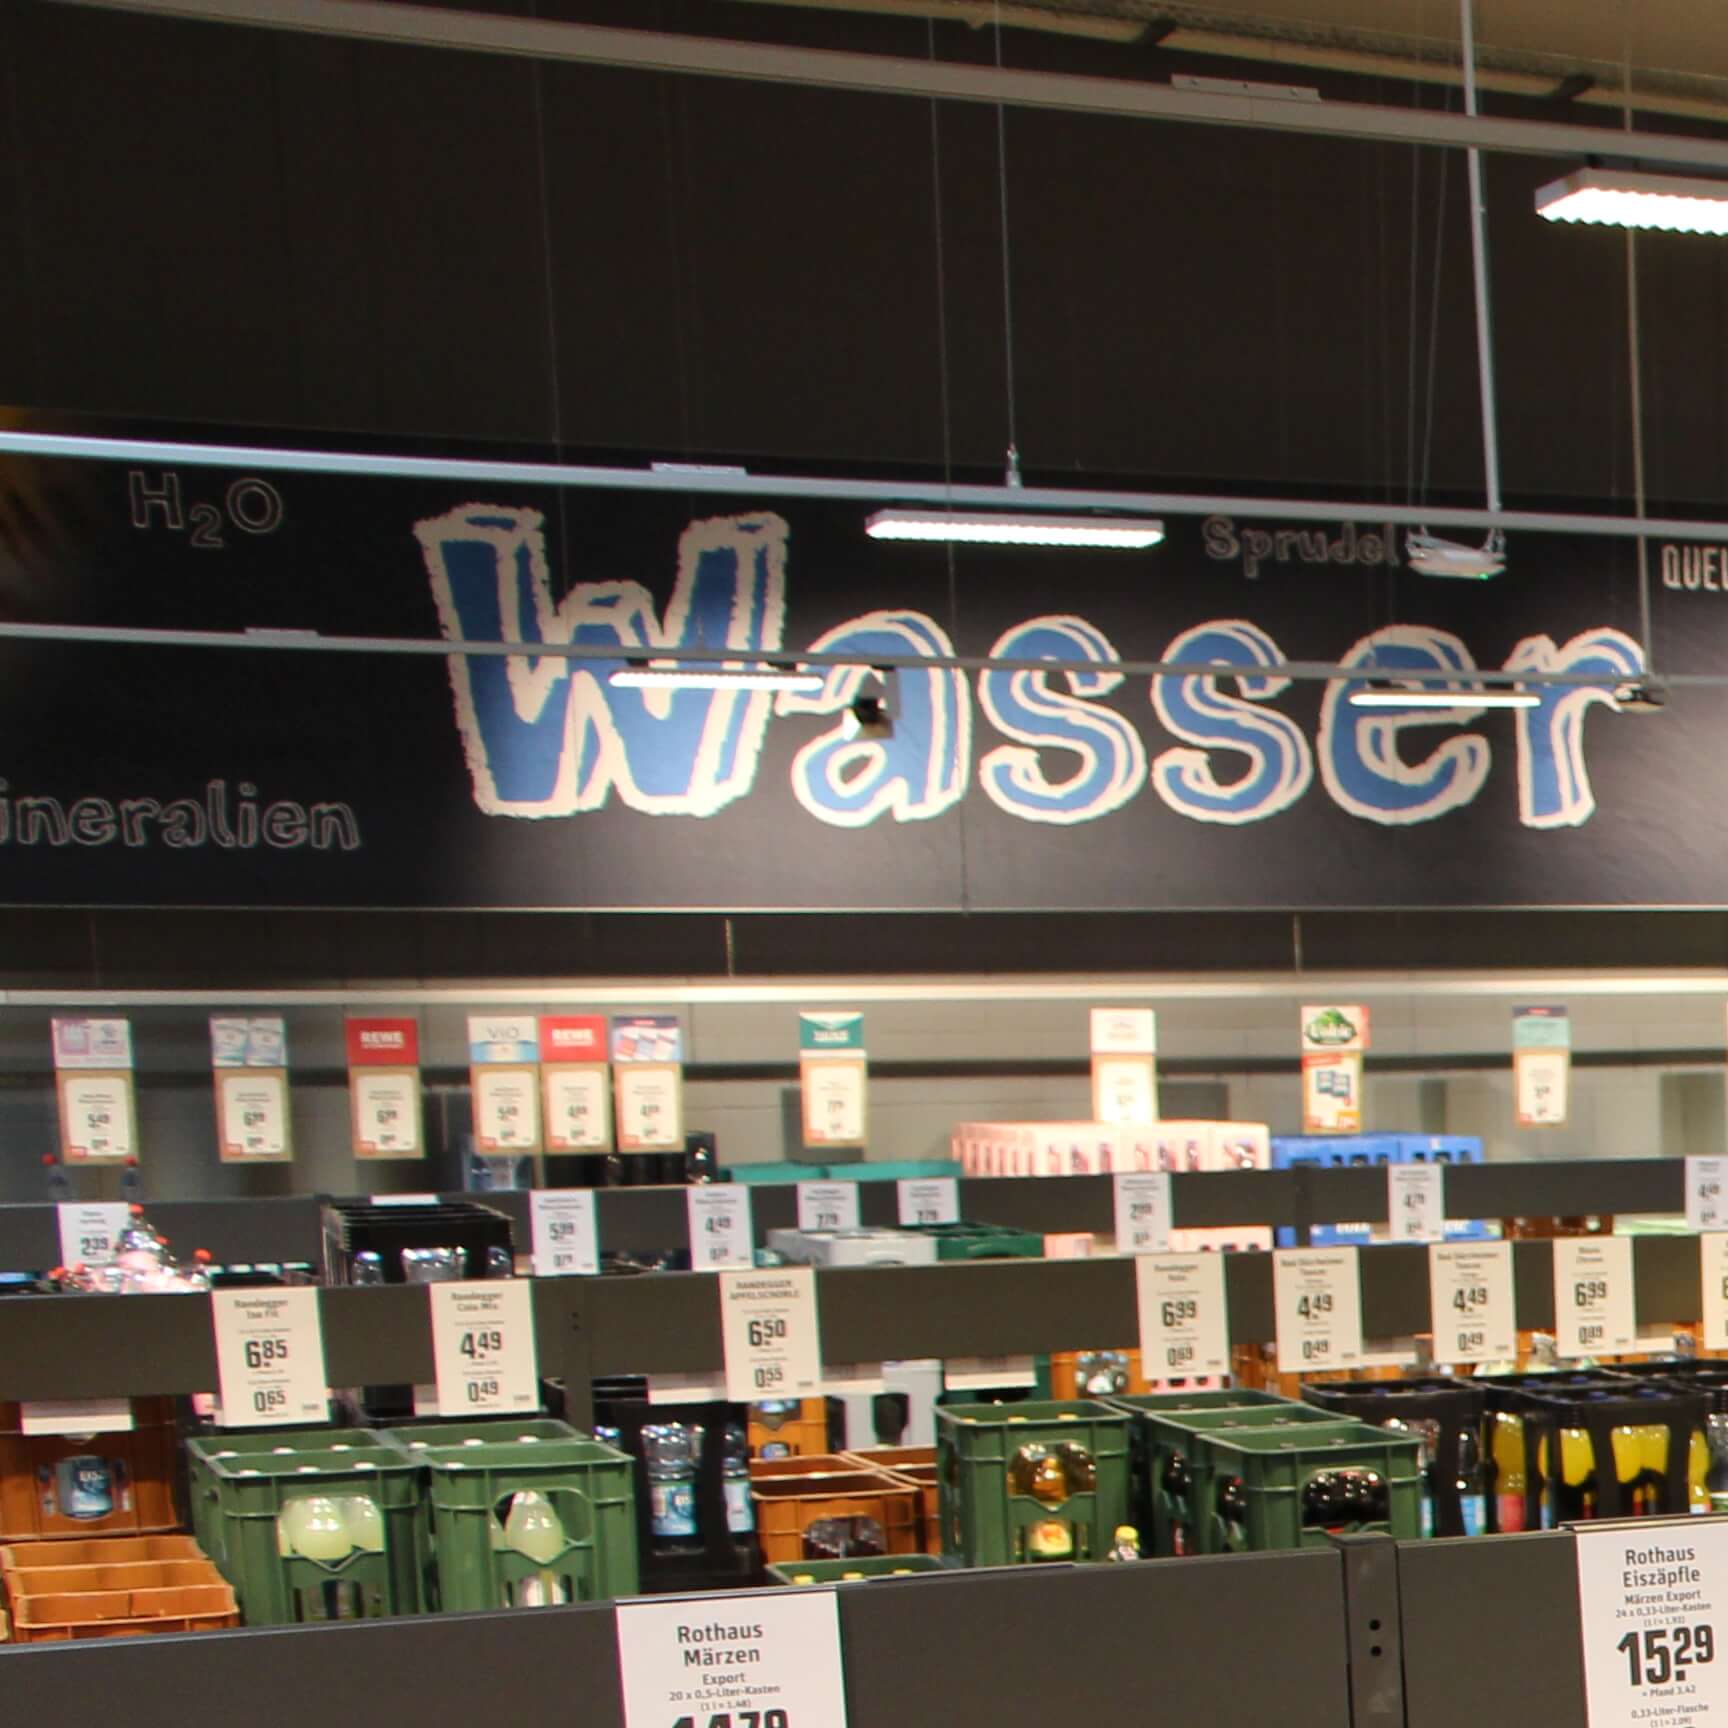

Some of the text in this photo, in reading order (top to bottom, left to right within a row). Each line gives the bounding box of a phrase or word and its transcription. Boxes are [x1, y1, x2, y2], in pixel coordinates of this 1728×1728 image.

[1202, 514, 1399, 579] Sprudel
[413, 501, 1647, 829] Wasser
[0, 780, 359, 851] ineralien
[1625, 1545, 1696, 1567] Rothaus
[1623, 1566, 1701, 1588] Eiszäpfle
[1624, 1588, 1701, 1606] Märzen Export
[677, 1621, 764, 1644] Rothaus
[683, 1645, 761, 1667] Märzen
[702, 1672, 746, 1687] Export
